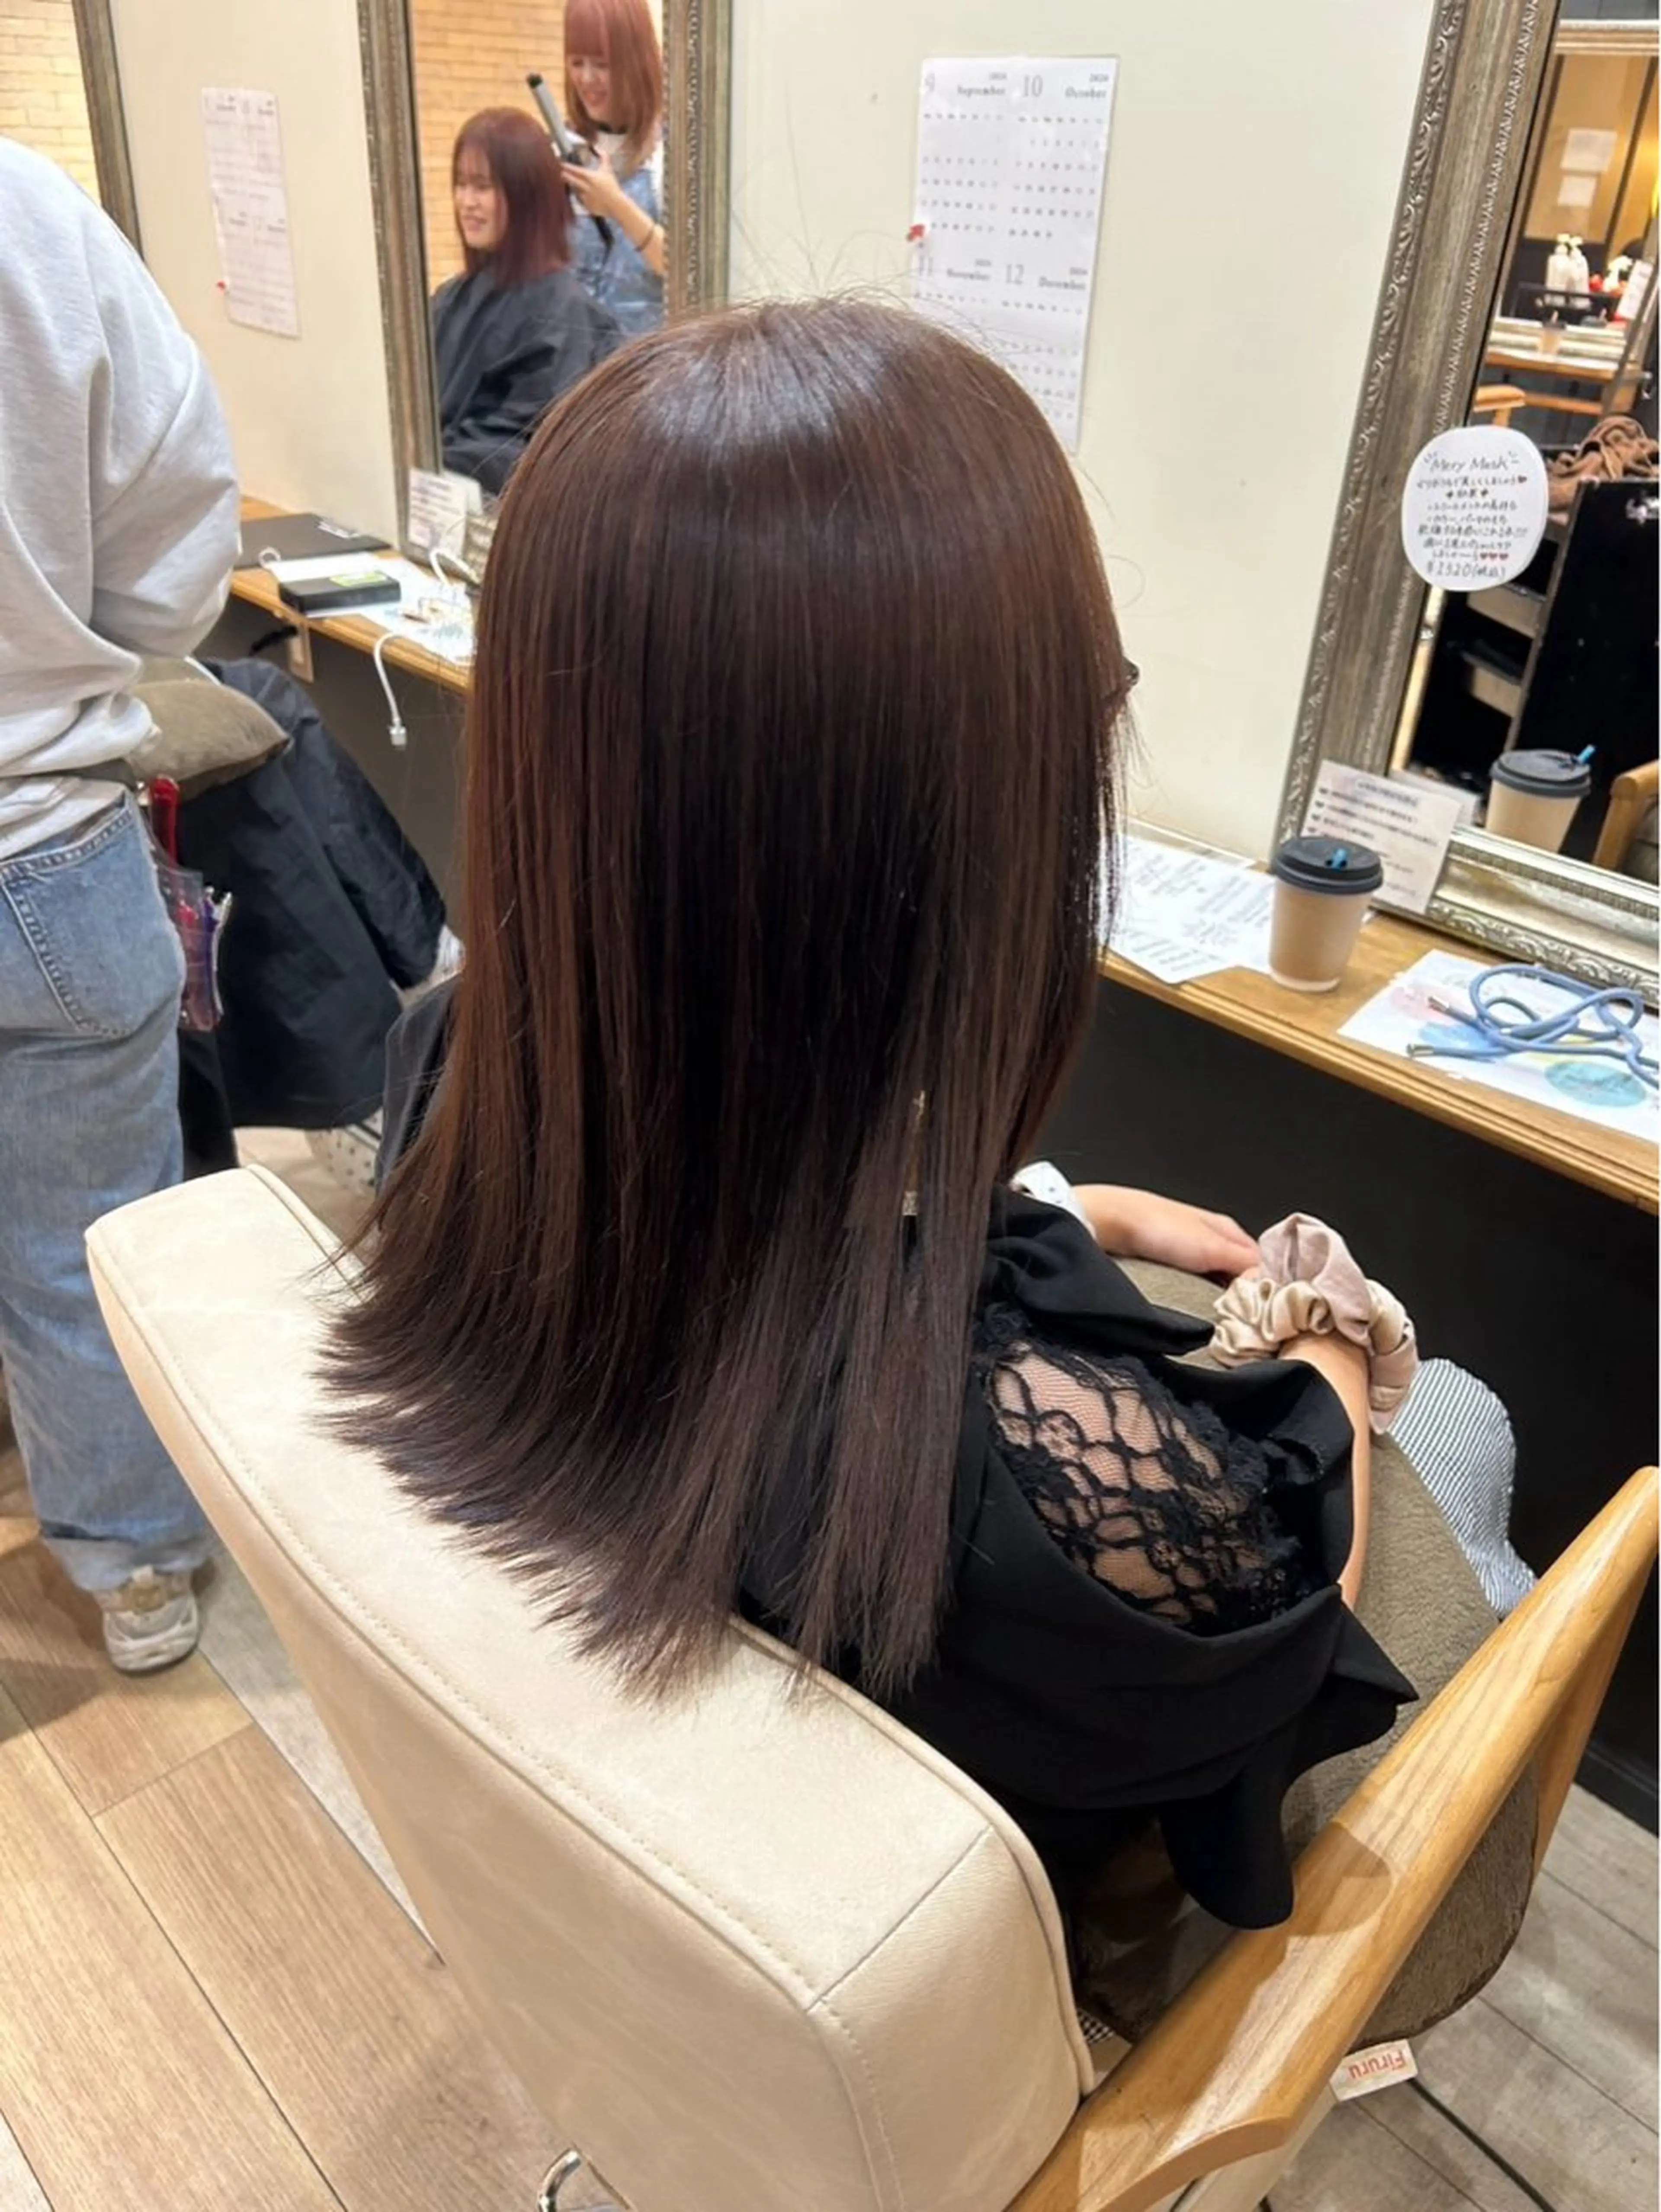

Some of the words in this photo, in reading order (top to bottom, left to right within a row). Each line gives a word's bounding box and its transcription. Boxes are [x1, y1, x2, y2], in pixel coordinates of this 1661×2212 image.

[1024, 74, 1043, 98] 10
[1065, 86, 1106, 99] October
[1006, 264, 1024, 285] 12
[1348, 2049, 1406, 2079] Firuru
